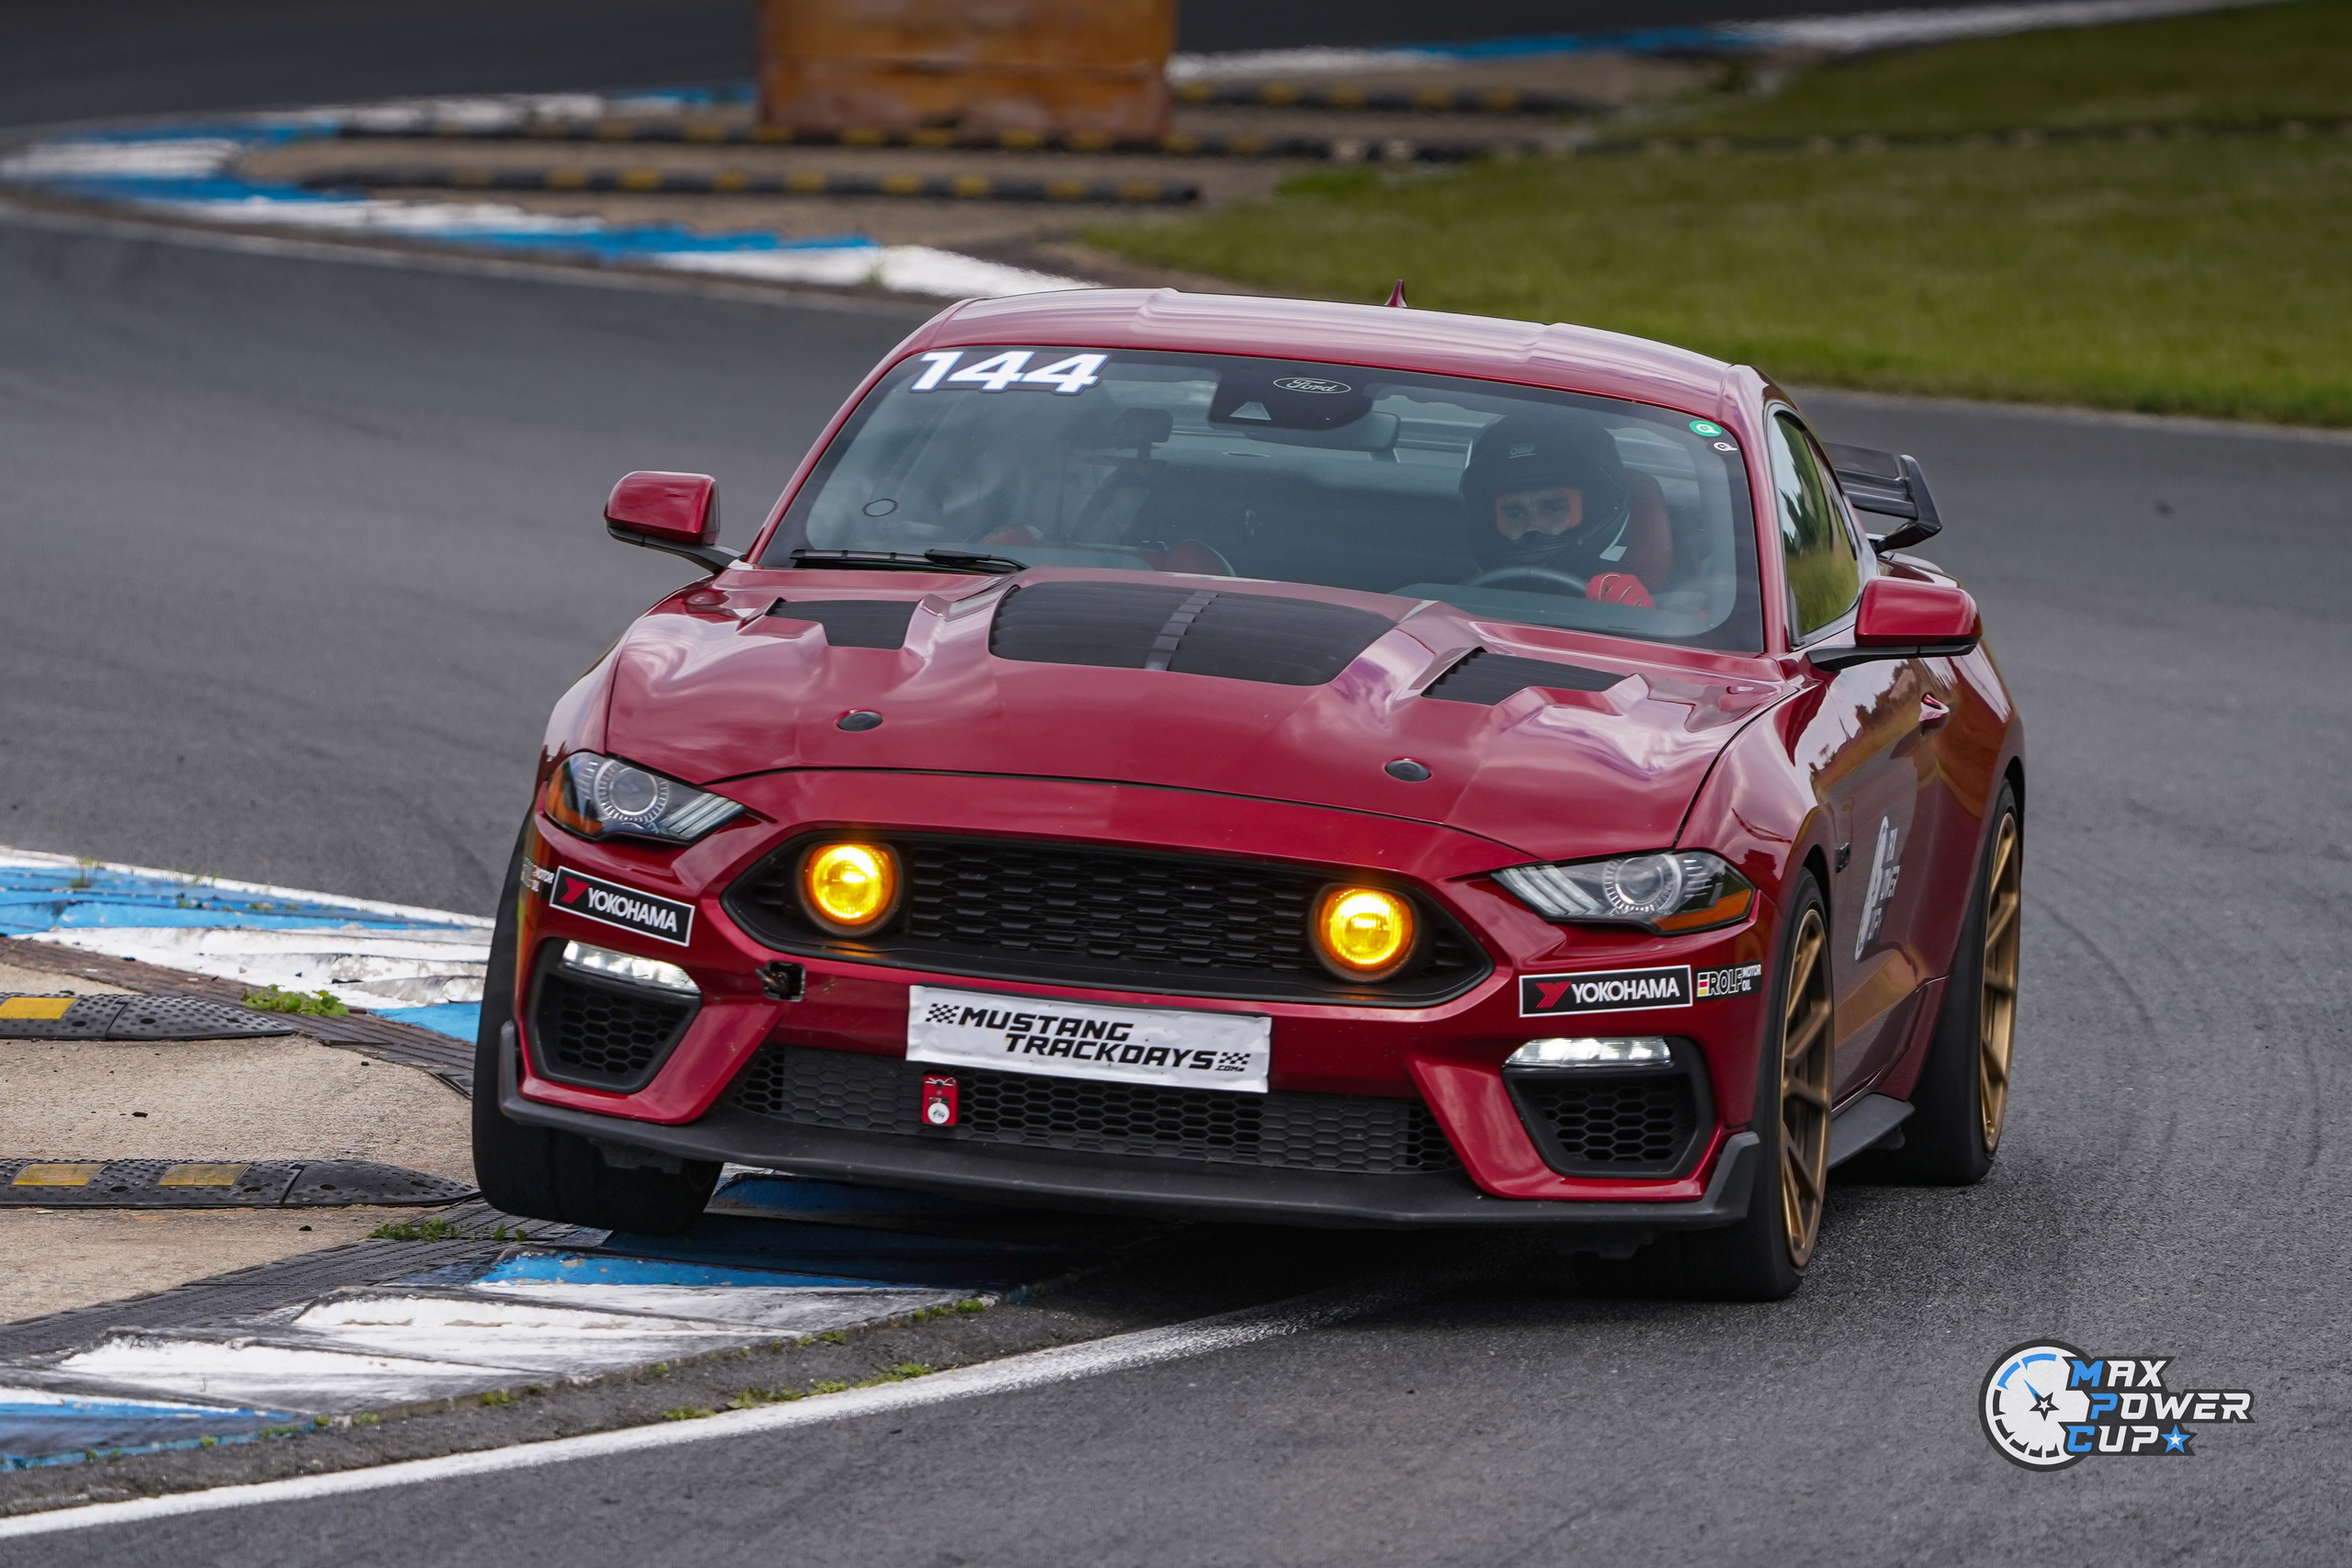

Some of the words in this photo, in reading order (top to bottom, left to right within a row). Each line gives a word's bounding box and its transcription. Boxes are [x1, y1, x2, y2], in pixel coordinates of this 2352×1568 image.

[911, 351, 1108, 393] 144
[1286, 378, 1339, 392] Ford
[588, 887, 677, 932] YOKOHAMA
[1571, 977, 1680, 1004] YOKOHAMA
[1708, 968, 1743, 995] ROLF
[1742, 964, 1762, 978] MOTOR
[1742, 978, 1752, 991] OIL
[958, 1007, 1135, 1043] MUSTANG
[1004, 1033, 1219, 1069] TRACKDAYS
